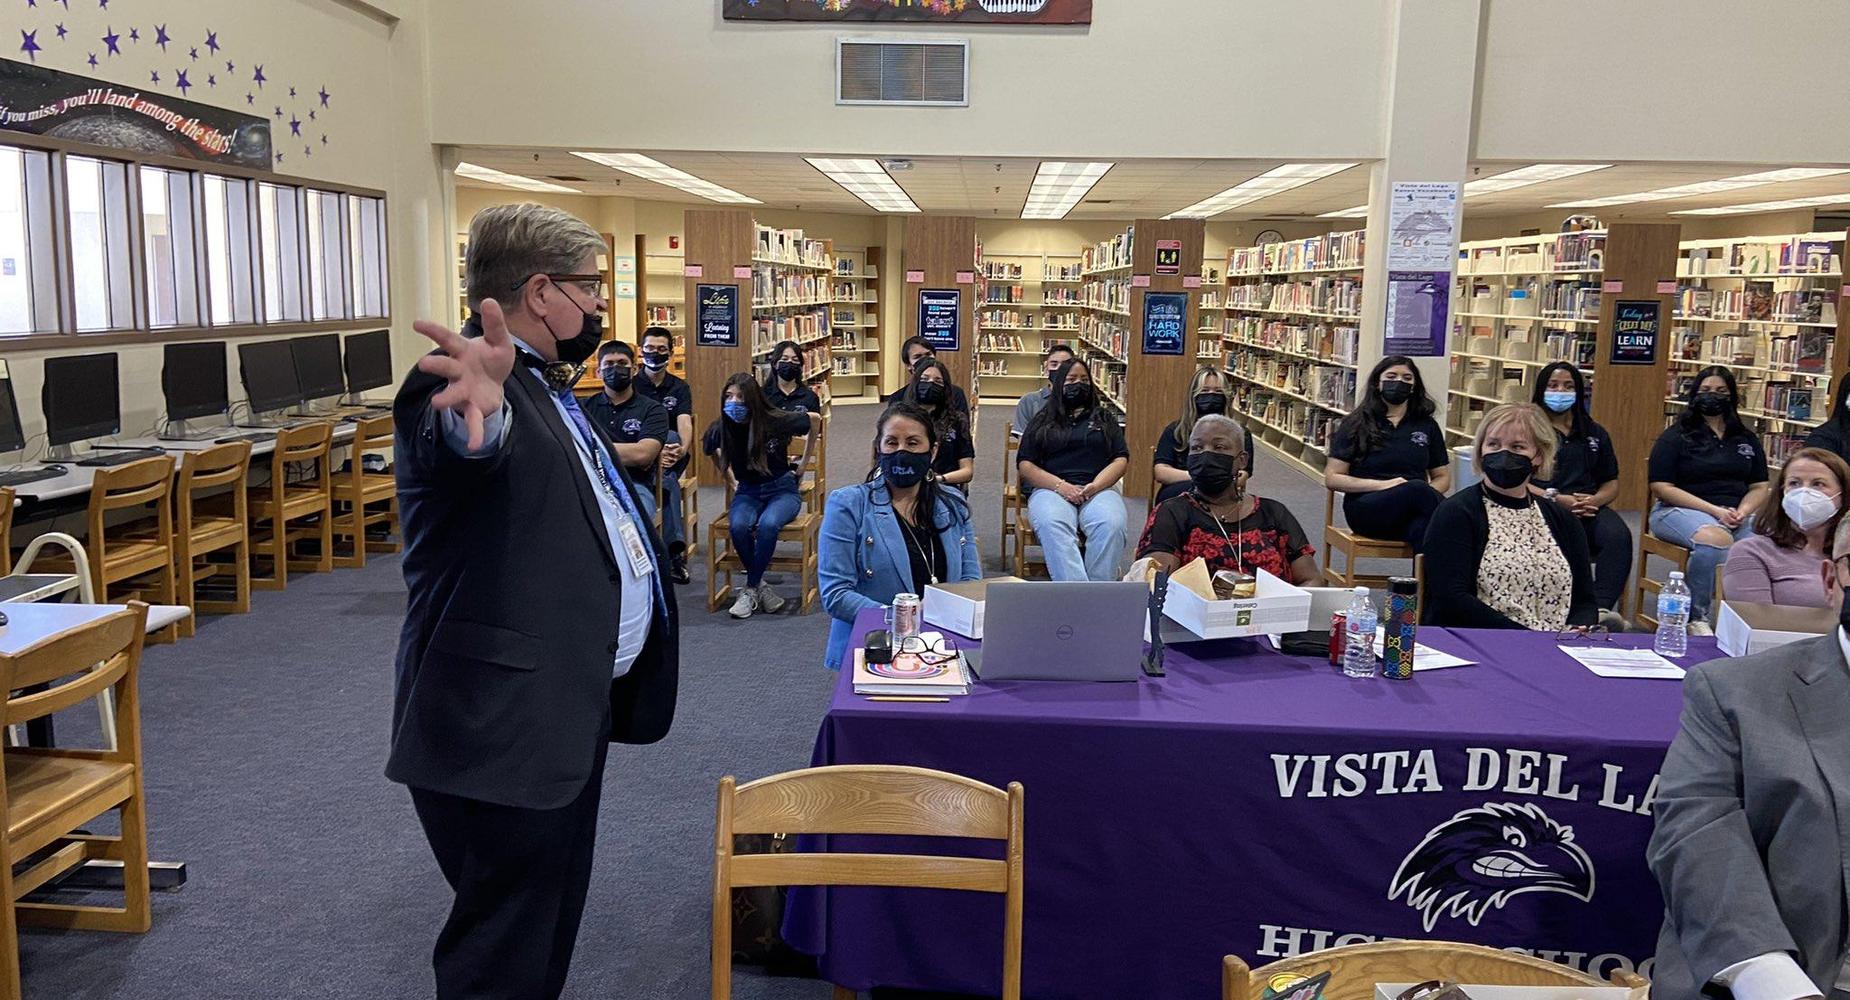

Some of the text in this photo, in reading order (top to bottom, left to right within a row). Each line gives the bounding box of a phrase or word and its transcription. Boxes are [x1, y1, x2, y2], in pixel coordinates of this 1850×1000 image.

[3, 111, 26, 124] you
[27, 104, 60, 122] miss,
[61, 88, 103, 114] you'll
[103, 88, 140, 110] land
[136, 100, 184, 131] among
[180, 118, 203, 140] the
[201, 128, 238, 154] stars!
[1149, 321, 1180, 330] HARD
[1149, 329, 1180, 338] WORK
[1617, 335, 1653, 346] LEARN
[1270, 749, 1443, 798] VISTA
[1463, 747, 1579, 800] DEL
